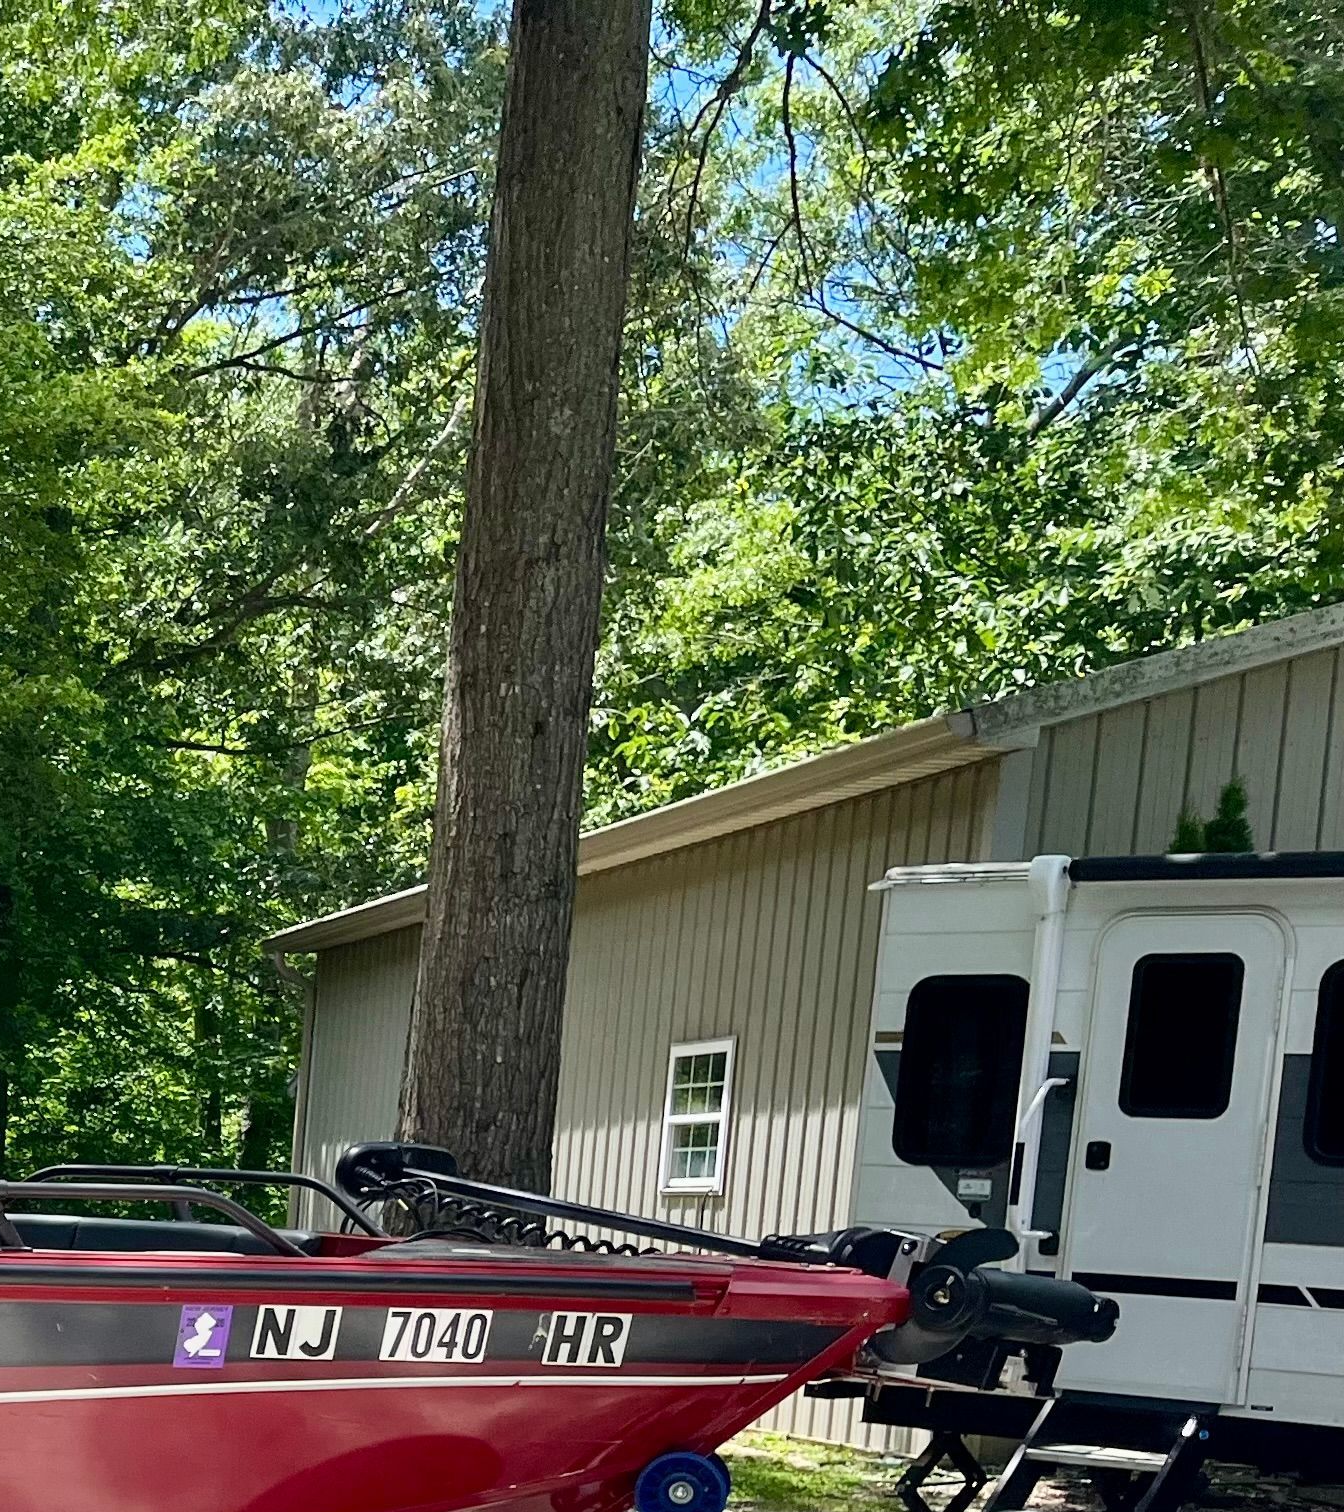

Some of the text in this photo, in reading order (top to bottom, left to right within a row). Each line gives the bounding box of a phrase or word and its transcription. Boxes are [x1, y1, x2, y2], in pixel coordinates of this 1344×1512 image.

[255, 1307, 625, 1366] NJ 7040 HR
